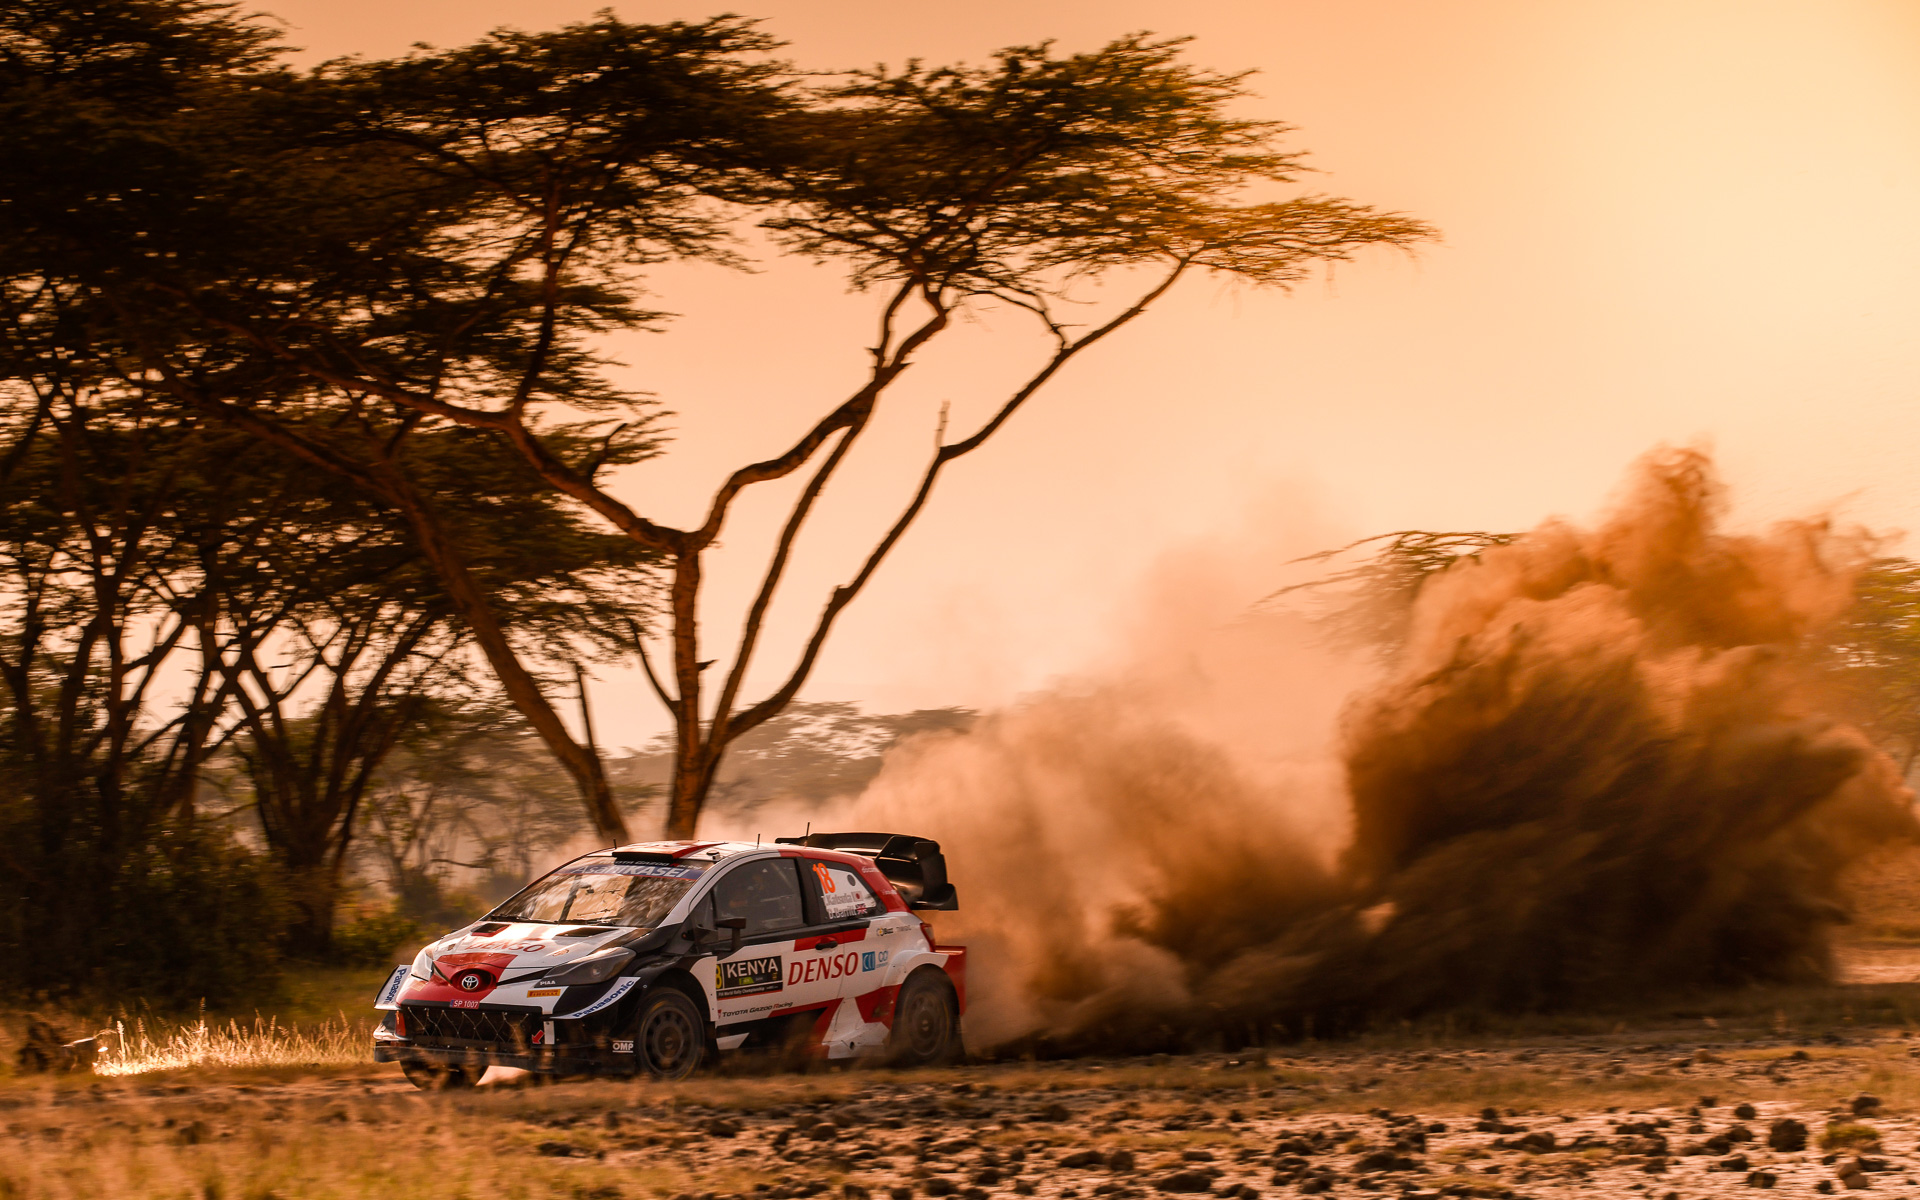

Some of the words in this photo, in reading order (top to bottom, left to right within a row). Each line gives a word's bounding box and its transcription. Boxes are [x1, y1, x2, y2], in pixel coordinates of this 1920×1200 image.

[812, 863, 836, 894] 18
[465, 940, 546, 953] DENSO
[726, 958, 779, 978] KENYA
[787, 952, 859, 986] DENSO
[464, 1000, 478, 1008] 1007
[573, 980, 635, 1018] Panasonic
[722, 1009, 748, 1017] TOYOTA
[749, 1005, 773, 1013] GAZOO
[773, 1002, 793, 1010] Racing
[612, 1042, 634, 1051] OMP
